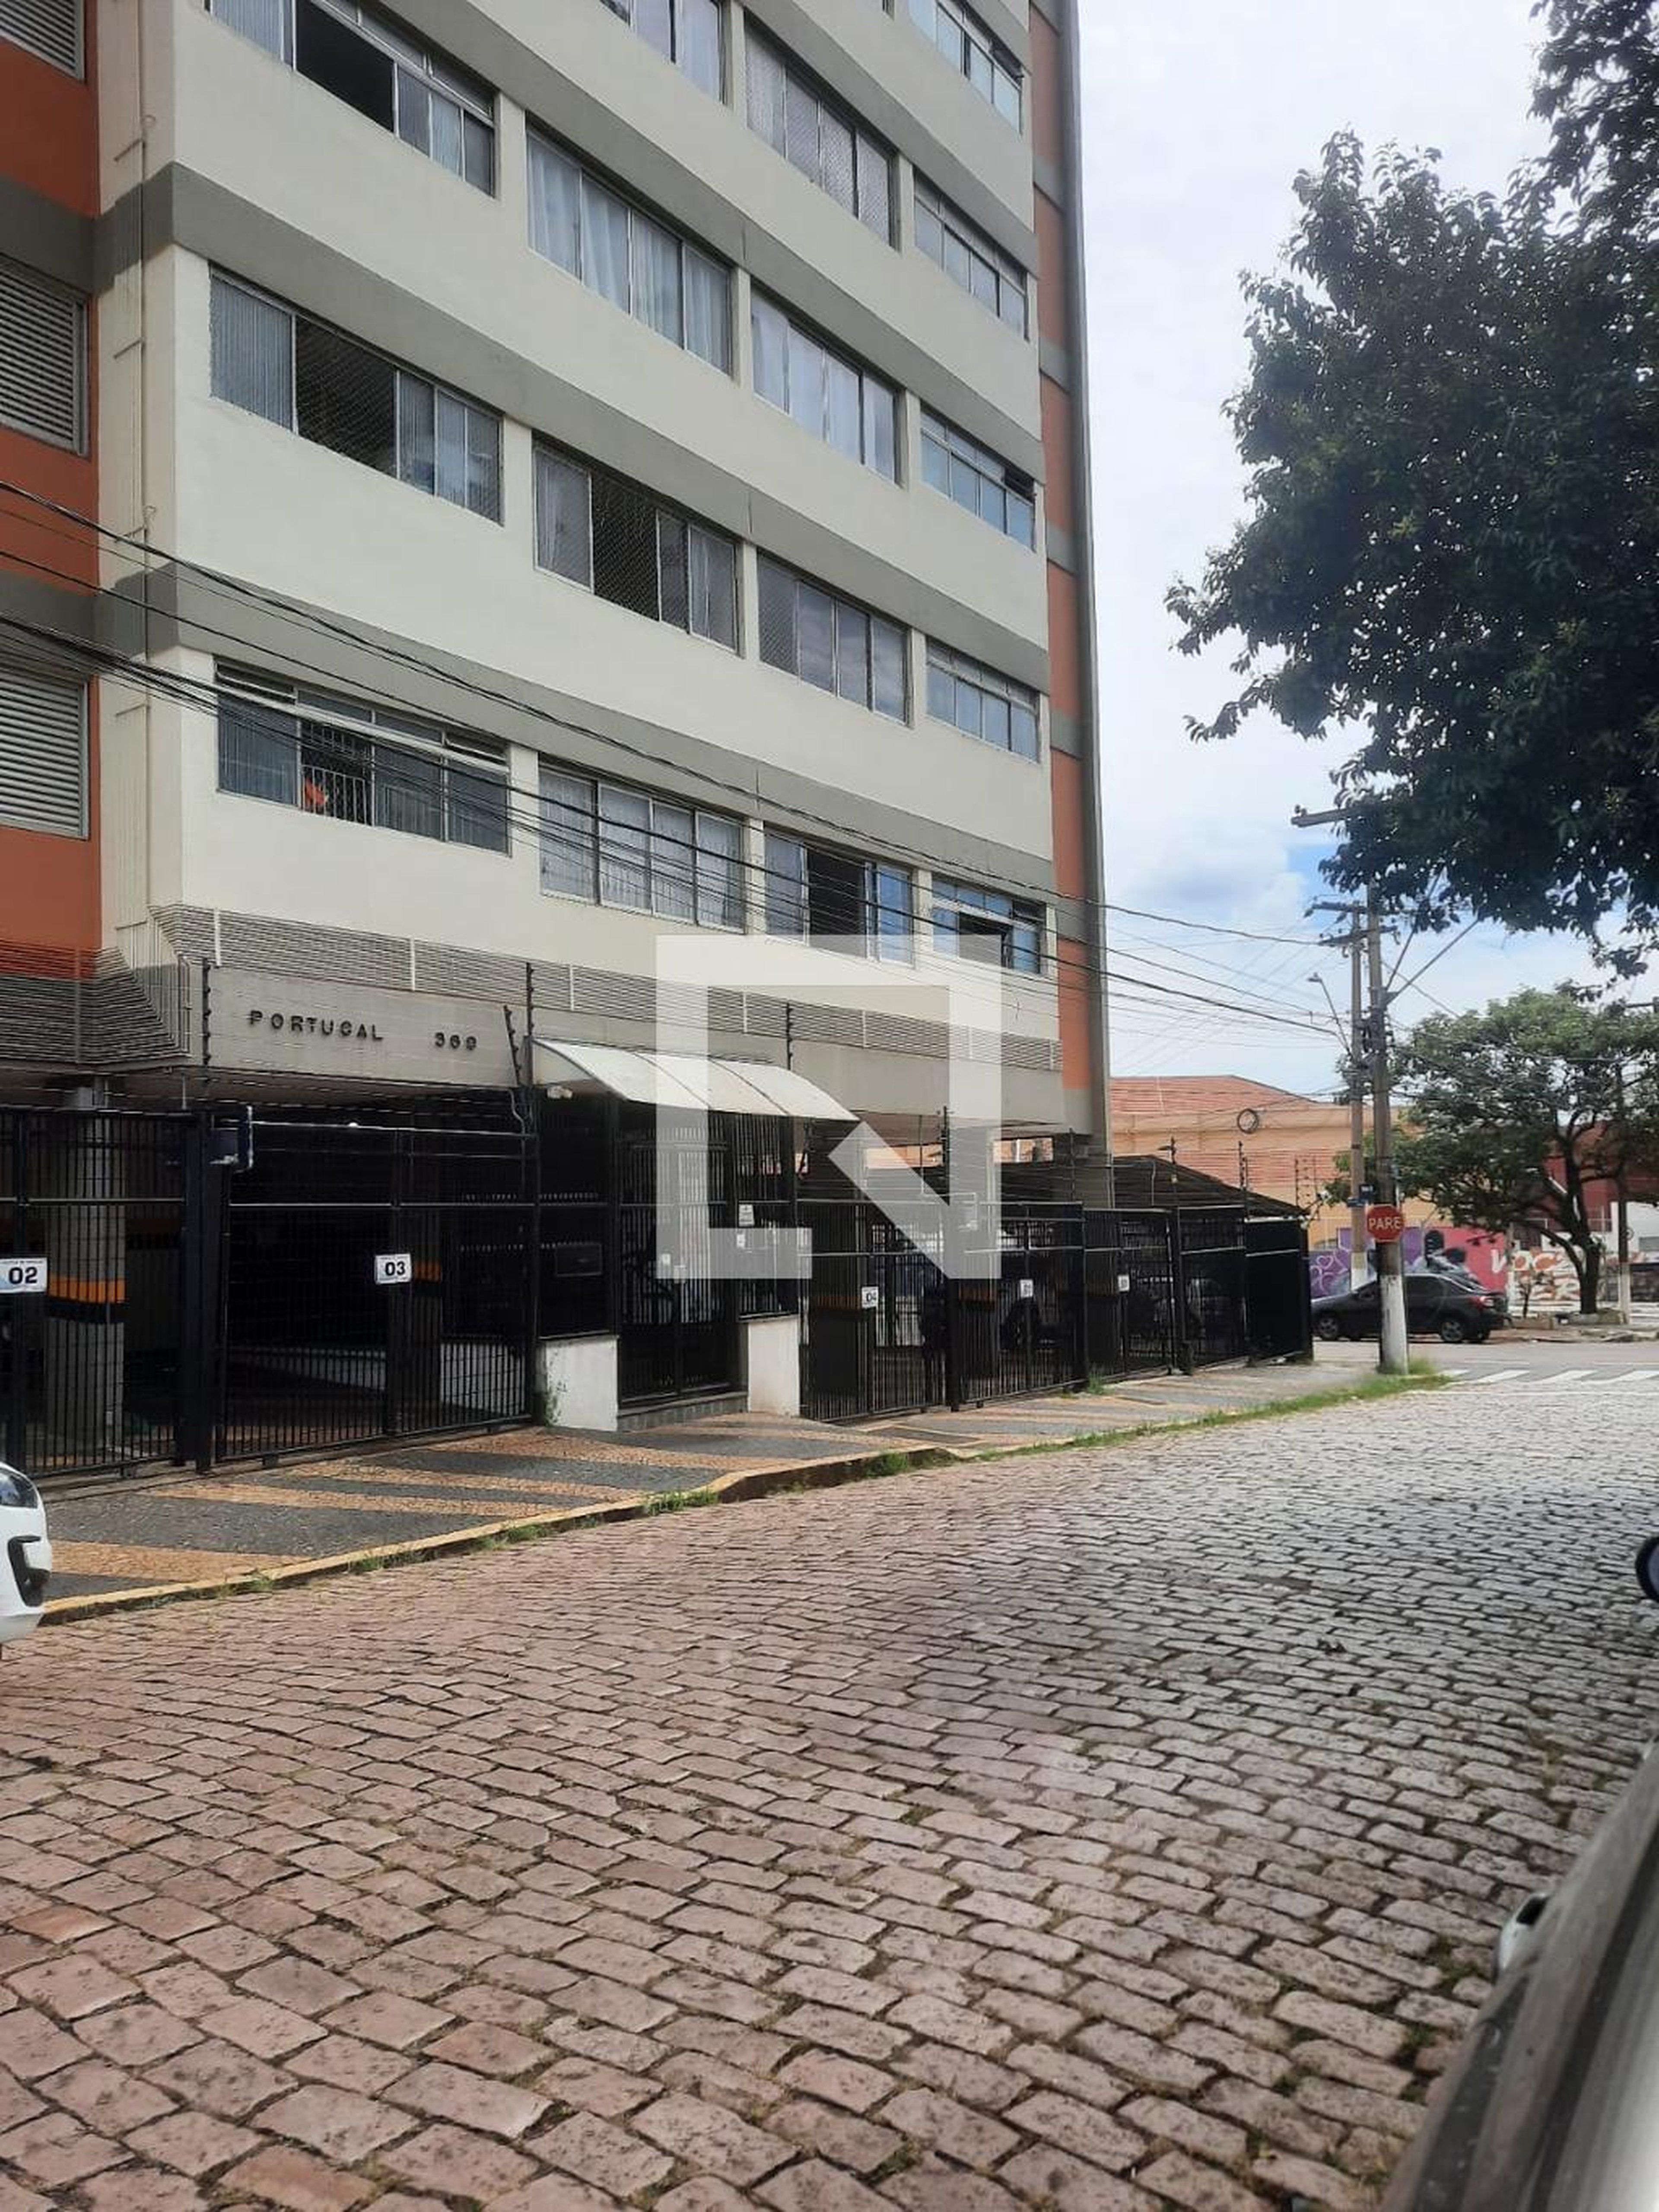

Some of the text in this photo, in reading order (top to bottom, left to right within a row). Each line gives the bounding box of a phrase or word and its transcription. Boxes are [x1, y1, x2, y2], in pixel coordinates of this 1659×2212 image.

[248, 1009, 384, 1041] PORTUGAL
[1368, 1216, 1402, 1231] PARE
[9, 1266, 38, 1285] 02
[385, 1260, 406, 1276] 03
